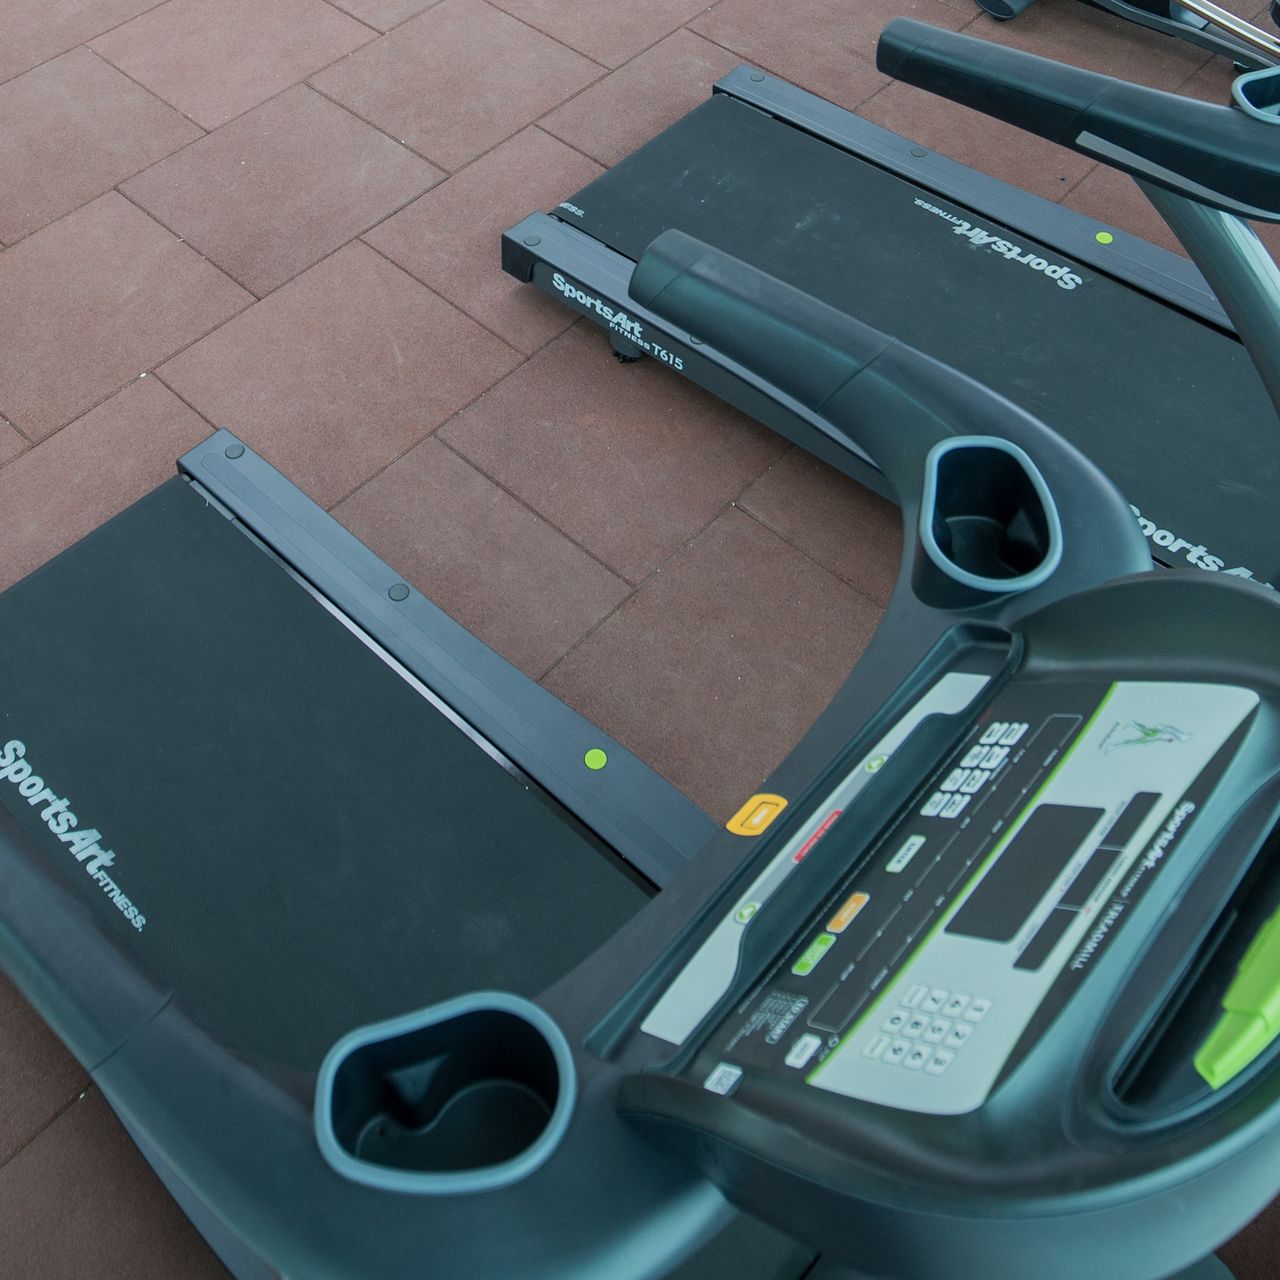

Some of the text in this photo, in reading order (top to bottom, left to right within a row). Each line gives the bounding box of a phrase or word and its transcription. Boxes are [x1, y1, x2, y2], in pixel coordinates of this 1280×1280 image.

[952, 222, 1083, 290] SportsArt
[552, 272, 644, 338] SportsArt
[651, 342, 684, 371] T615
[1145, 799, 1197, 873] SportsArt
[92, 870, 147, 932] FITNESS
[1070, 900, 1126, 973] TREADMILL
